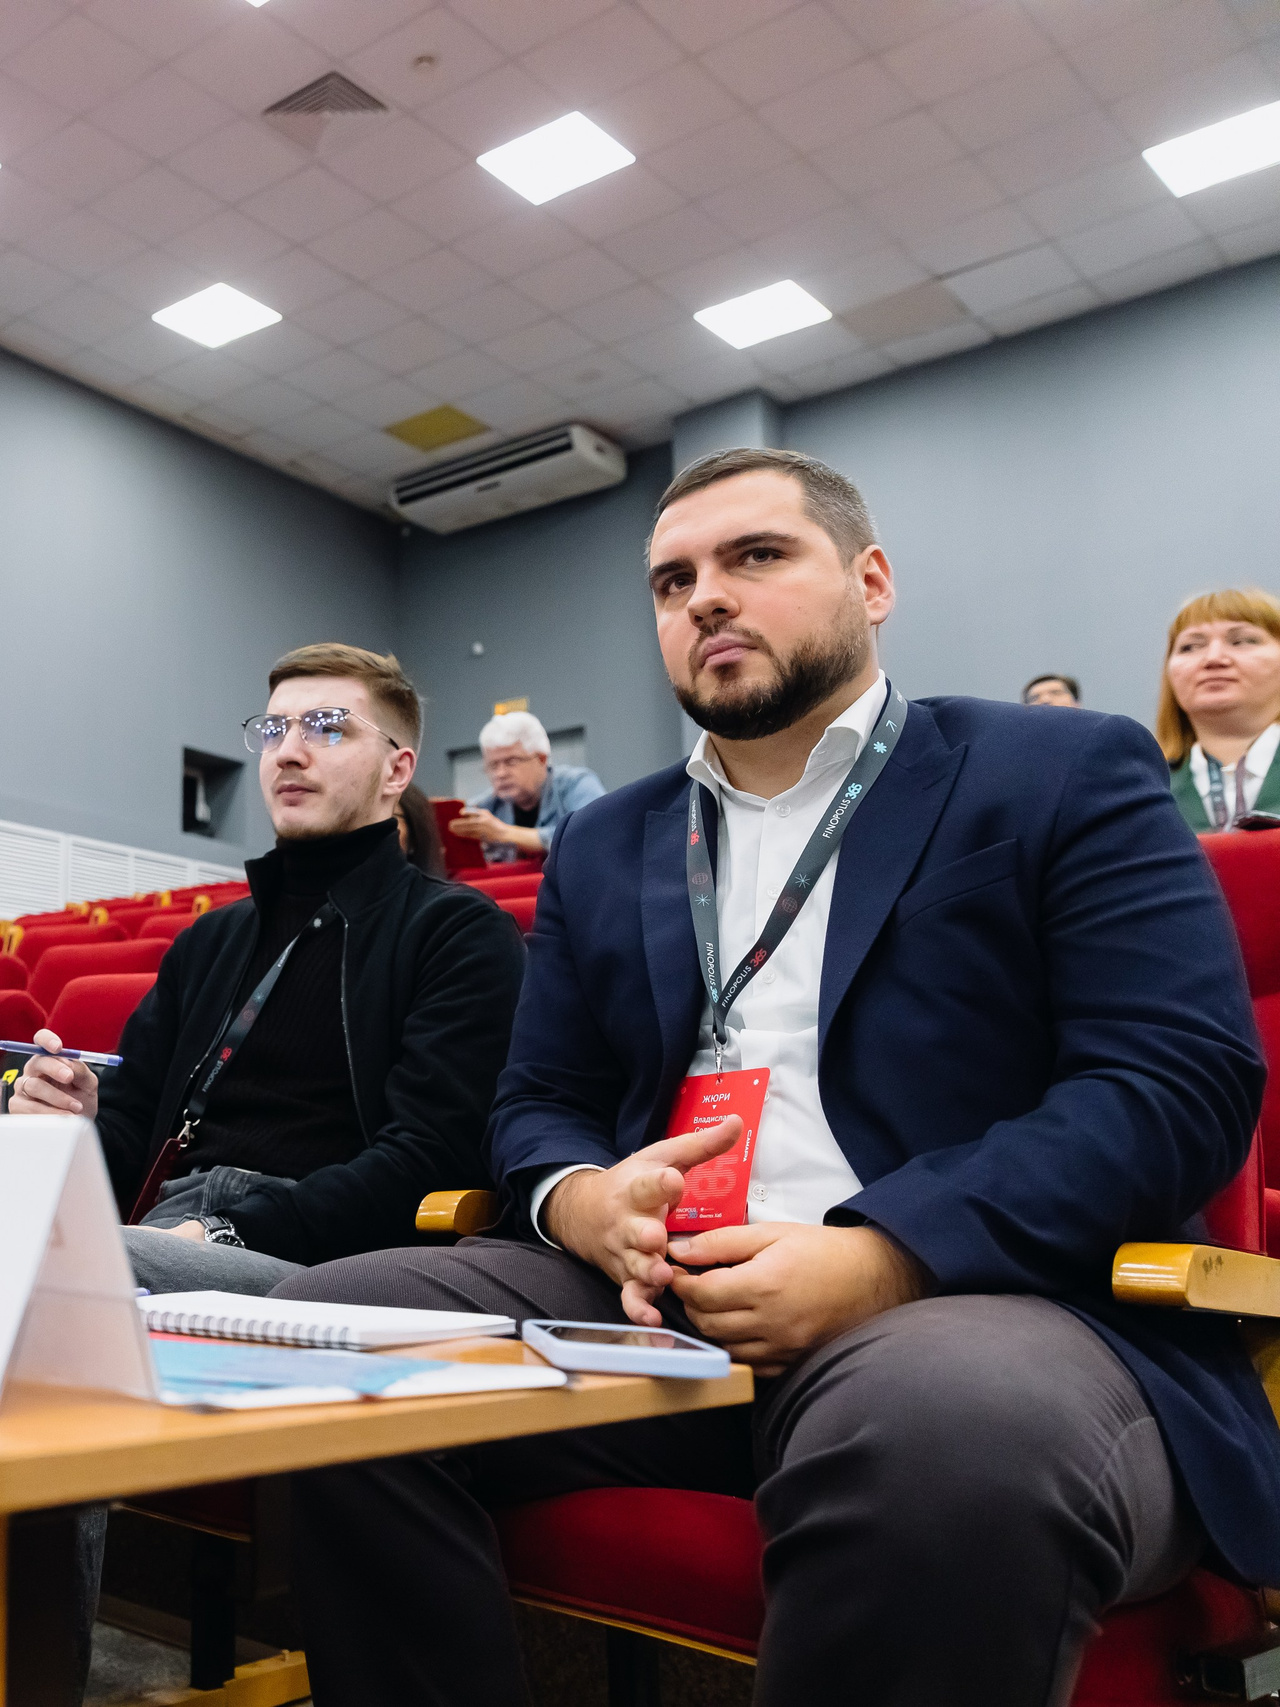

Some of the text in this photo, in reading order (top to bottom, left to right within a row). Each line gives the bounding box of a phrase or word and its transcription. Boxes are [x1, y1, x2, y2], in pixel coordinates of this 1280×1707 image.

[822, 782, 863, 839] FINOPOLIS 365
[705, 941, 717, 986] FINOPOLIS
[721, 948, 767, 1008] FINOPOLIS 365
[693, 1115, 728, 1124] Владисла
[702, 1093, 730, 1103] ЖЮРИ
